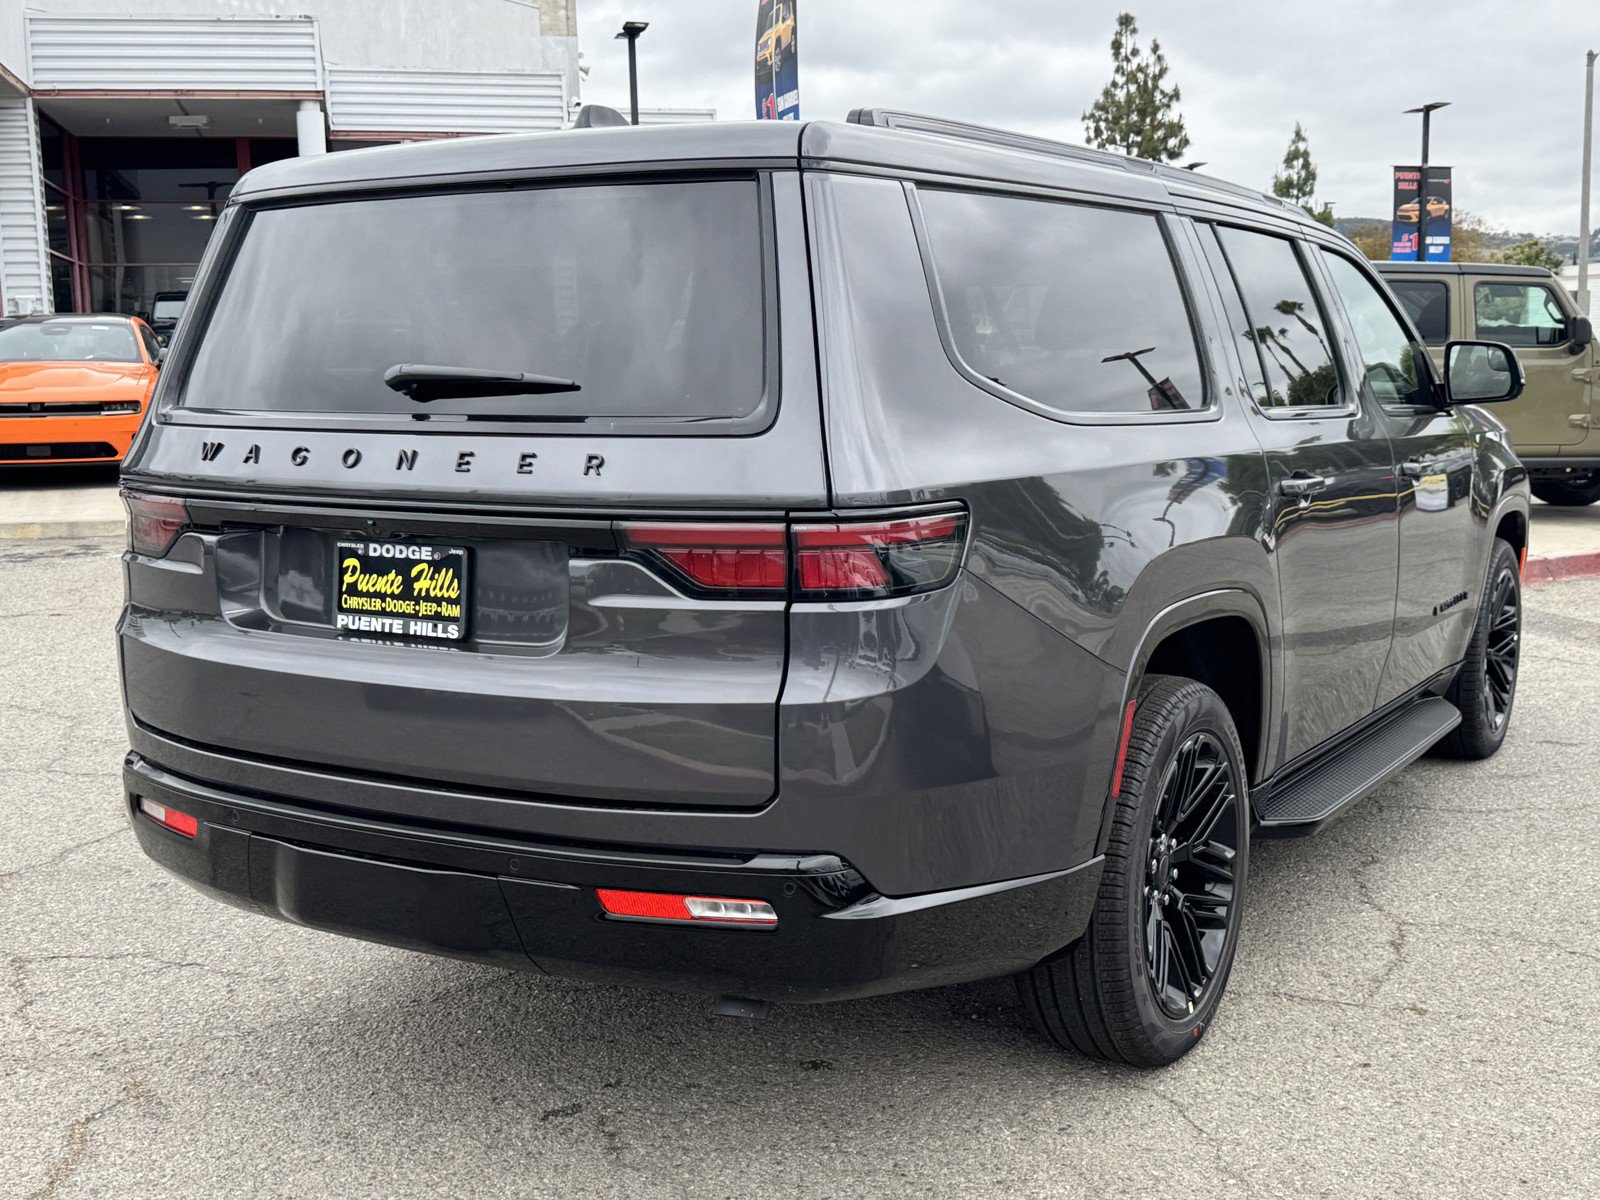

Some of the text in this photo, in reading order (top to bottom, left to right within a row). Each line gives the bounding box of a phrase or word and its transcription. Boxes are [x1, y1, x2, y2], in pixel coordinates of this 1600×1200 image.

[200, 441, 605, 476] WAGONEER
[369, 543, 432, 560] DODGE
[342, 558, 460, 599] Puente Hills
[337, 615, 459, 639] PUENTE HILLS
